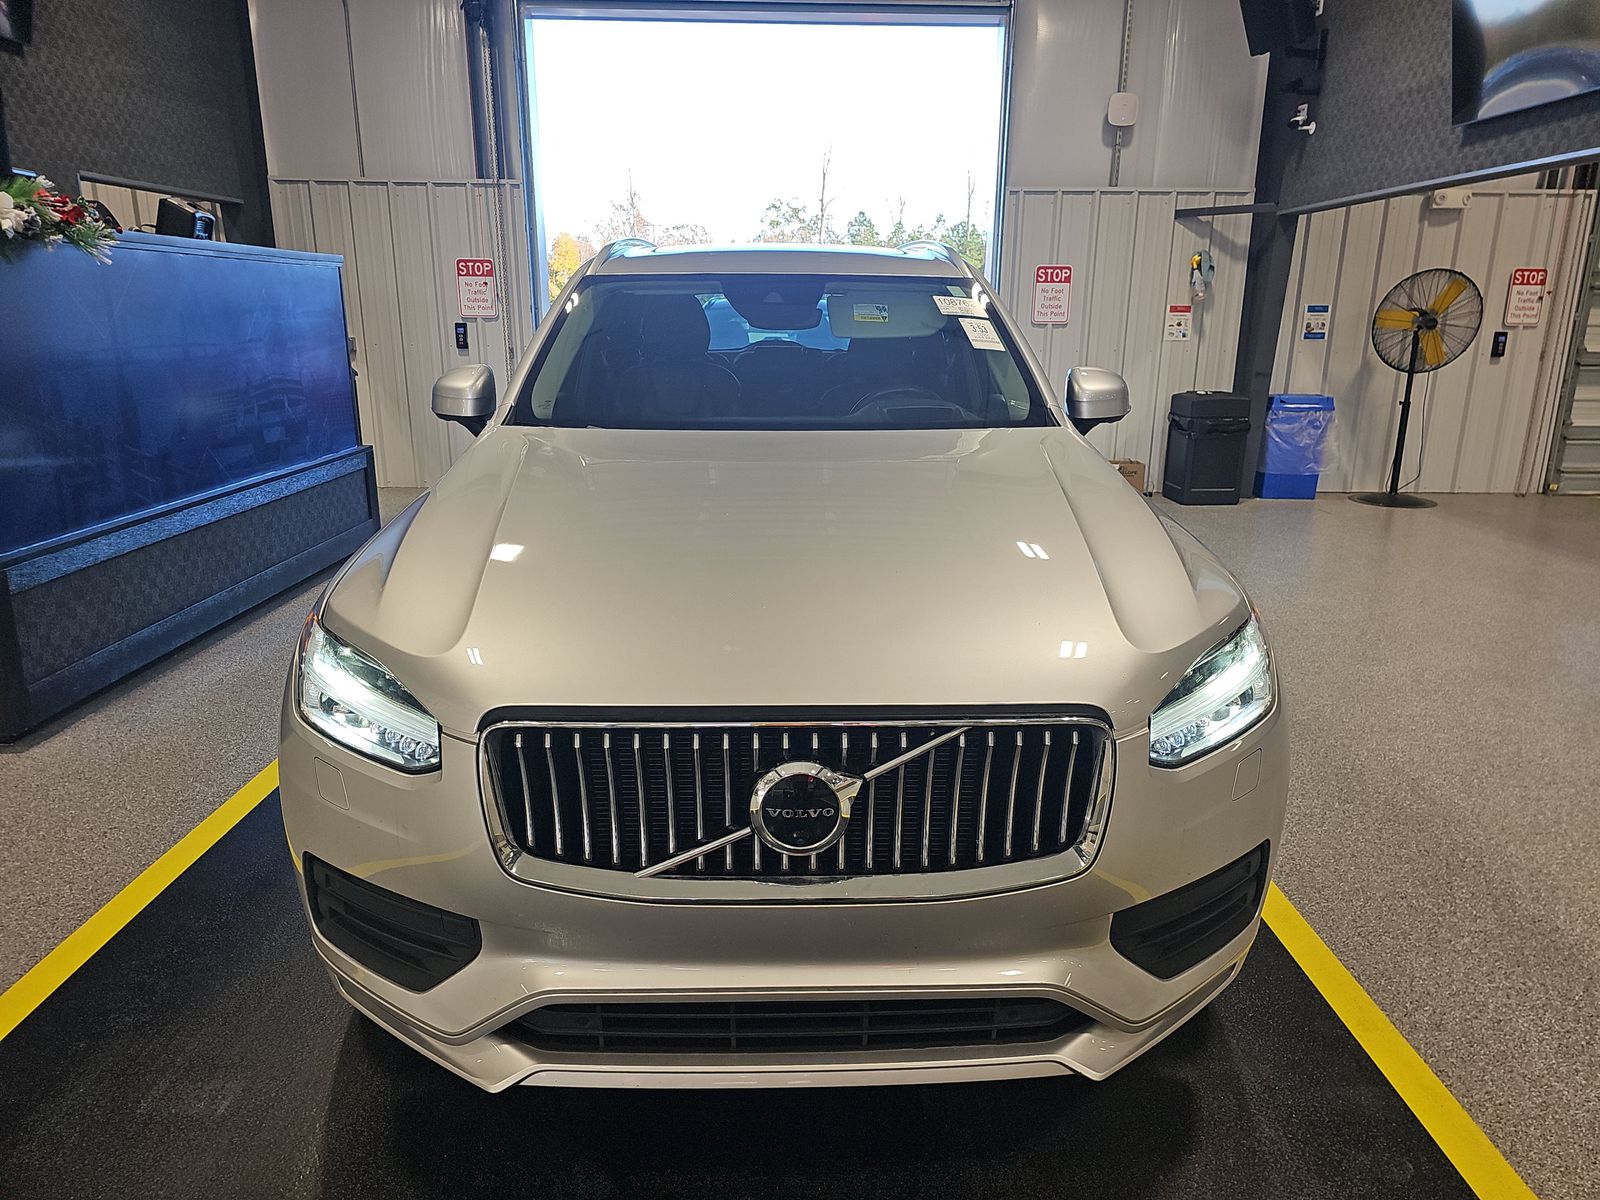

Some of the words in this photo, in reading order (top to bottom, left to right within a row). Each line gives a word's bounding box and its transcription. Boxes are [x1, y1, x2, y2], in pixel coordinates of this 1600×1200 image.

[458, 262, 491, 275] STOP
[1037, 269, 1070, 282] STOP
[1514, 271, 1546, 284] STOP
[970, 324, 989, 334] 3:53
[766, 807, 835, 818] VOLVO
